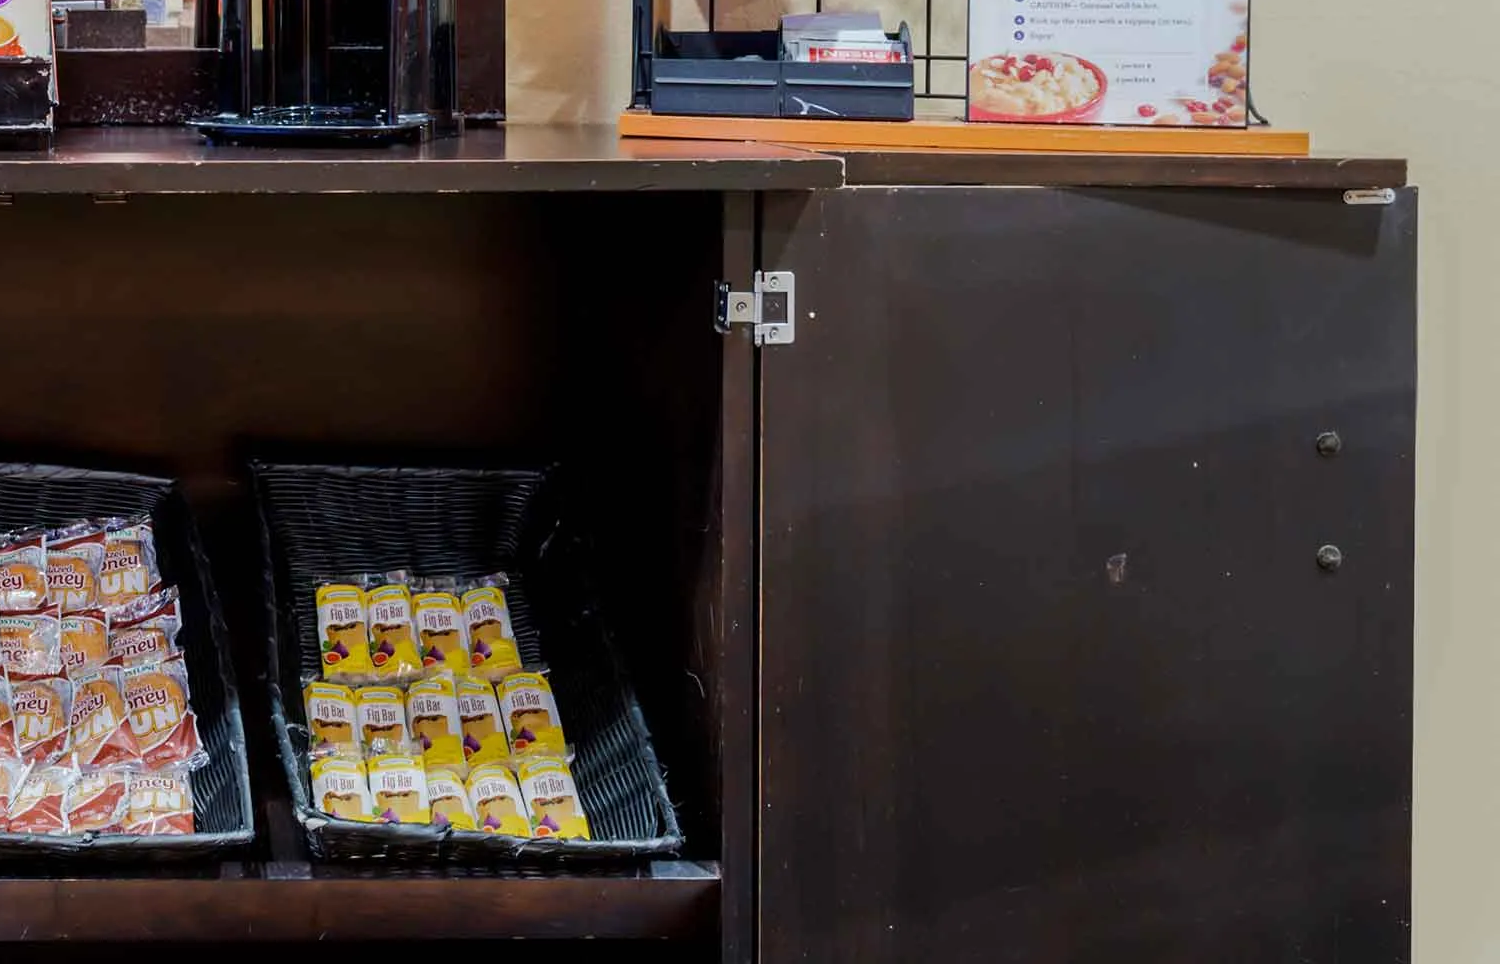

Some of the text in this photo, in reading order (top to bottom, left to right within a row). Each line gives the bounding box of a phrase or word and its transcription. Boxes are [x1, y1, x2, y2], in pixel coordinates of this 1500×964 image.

[47, 564, 72, 574] lazed
[102, 555, 138, 572] oney
[46, 574, 85, 589] oney
[101, 571, 146, 594] UN
[330, 606, 358, 621] Fig Bar
[375, 605, 404, 621] Fig Bar
[423, 611, 452, 629] Fig Bar
[125, 684, 151, 698] lazed
[15, 699, 48, 716] ney
[129, 690, 167, 709] ney
[413, 698, 440, 713] Fig Bar
[471, 697, 486, 711] Bar
[510, 691, 540, 708] Fig Bar
[71, 693, 104, 726] oney
[316, 703, 345, 718] Fig Bar
[366, 707, 396, 723] Fig Bar
[129, 701, 179, 737] UN
[130, 779, 175, 791] oney
[533, 778, 565, 796] Fig Bar
[130, 791, 182, 810] UN
